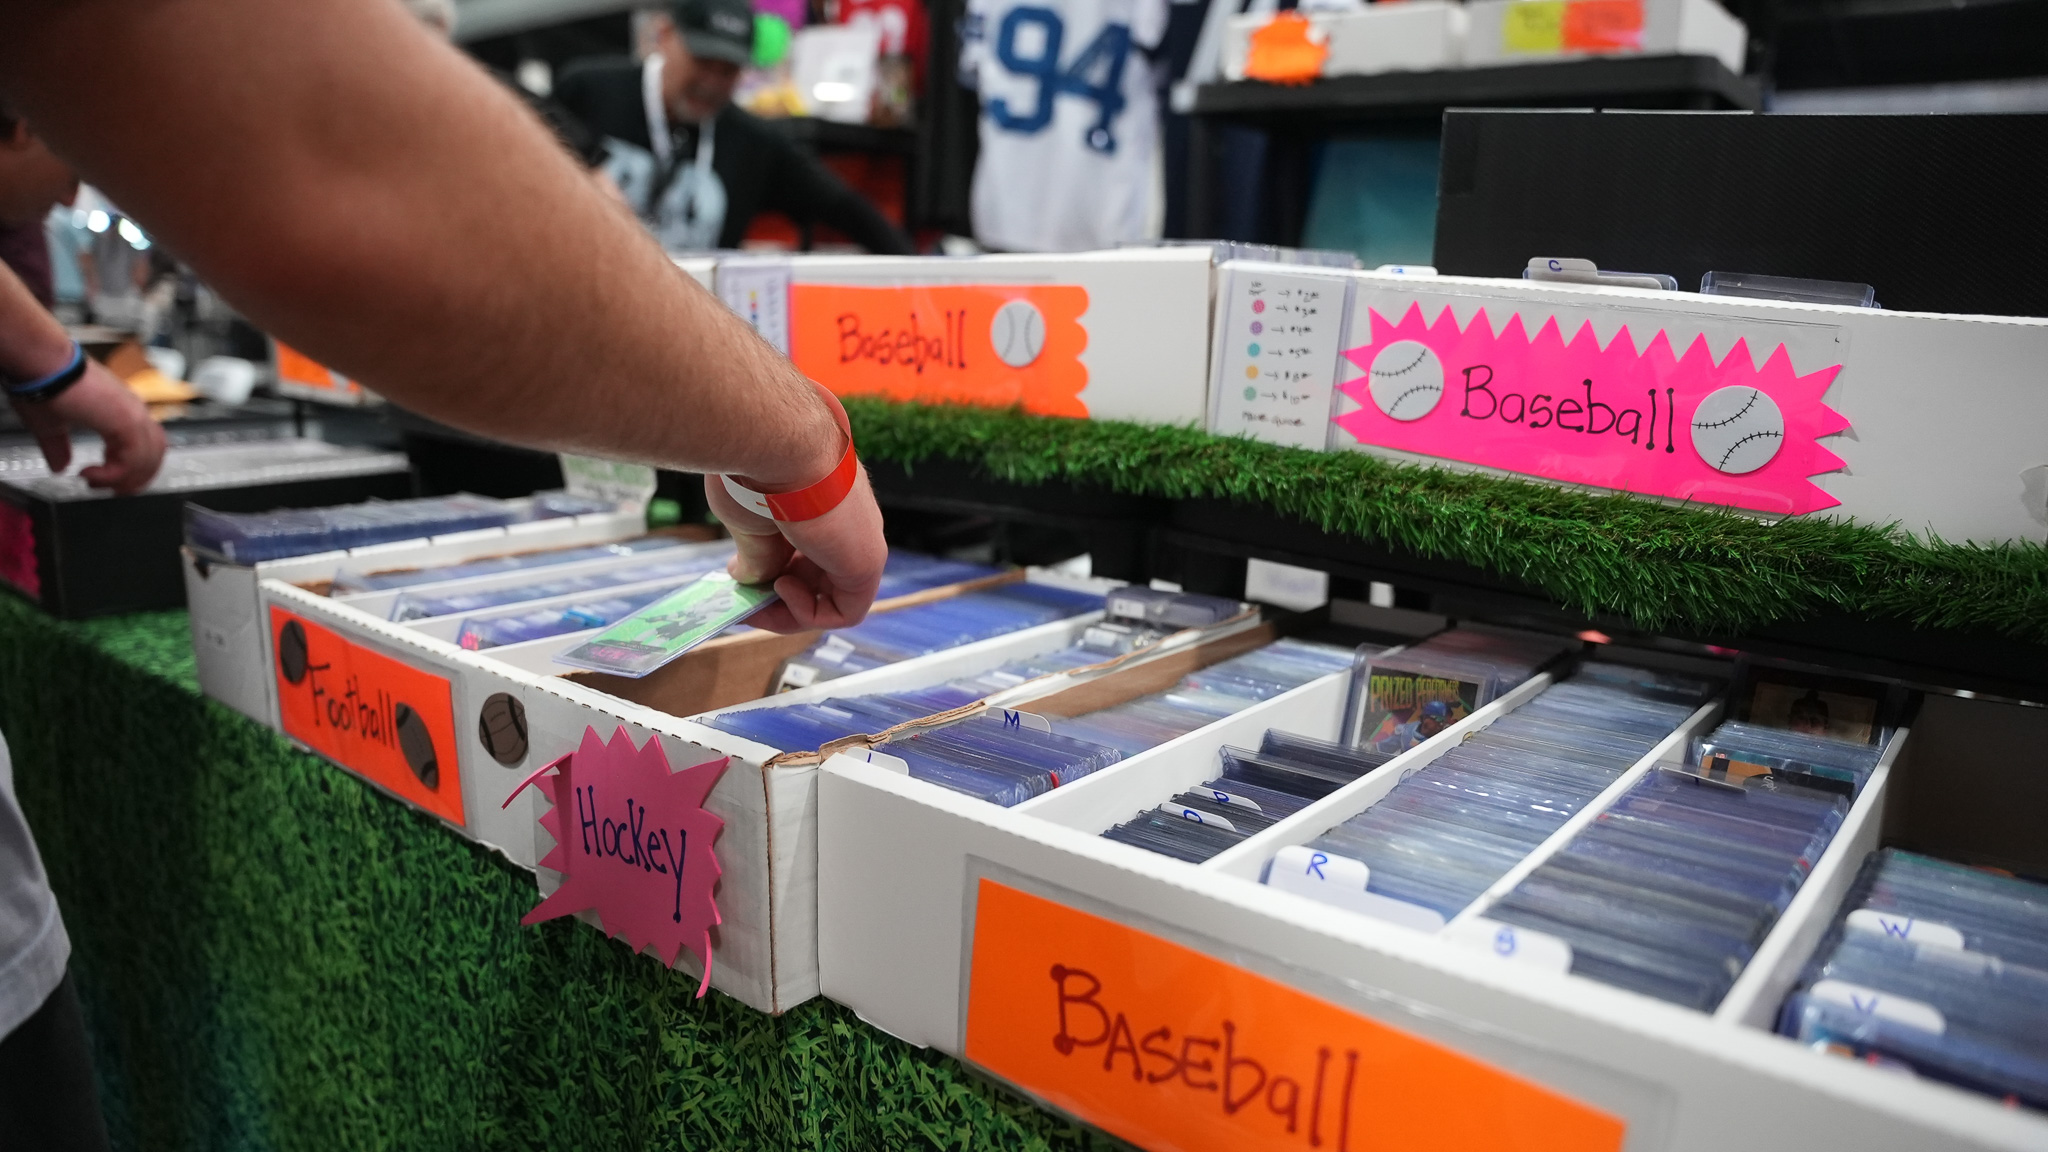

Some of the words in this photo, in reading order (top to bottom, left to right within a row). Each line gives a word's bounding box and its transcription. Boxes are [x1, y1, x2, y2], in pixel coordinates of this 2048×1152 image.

[986, 5, 1128, 156] 94
[1548, 259, 1562, 272] C
[836, 308, 966, 374] Baseball
[1460, 364, 1675, 453] Baseball
[307, 662, 395, 750] Football
[1370, 674, 1413, 713] PRIZED
[1004, 709, 1021, 730] M
[1306, 853, 1328, 880] R
[1879, 917, 1913, 939] W
